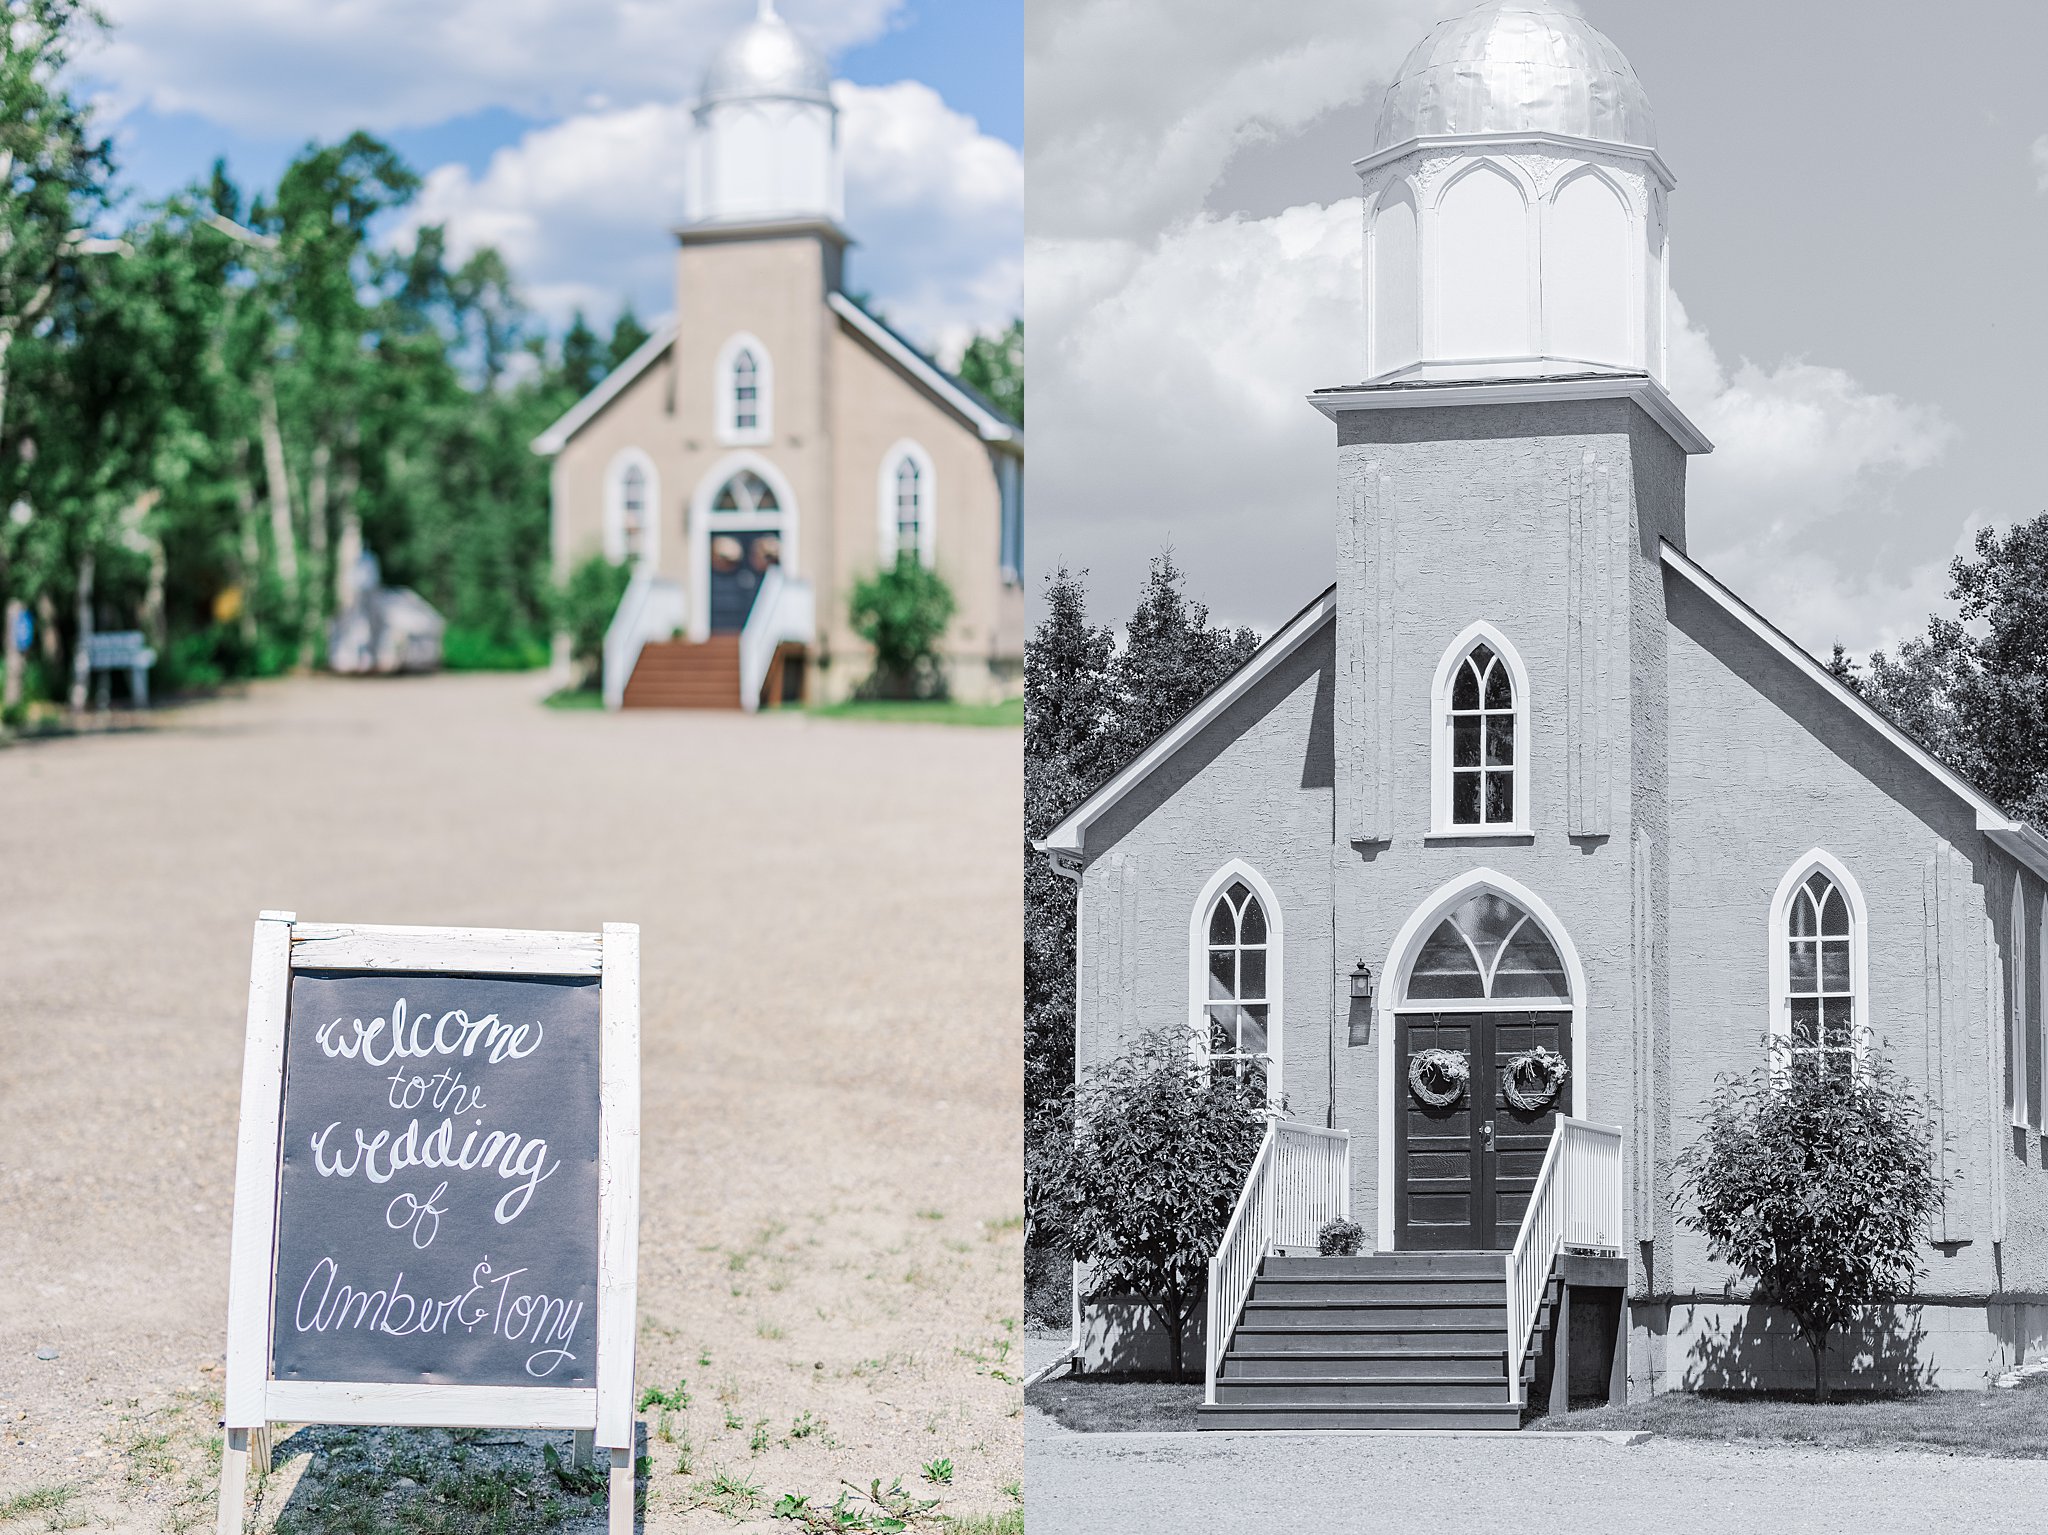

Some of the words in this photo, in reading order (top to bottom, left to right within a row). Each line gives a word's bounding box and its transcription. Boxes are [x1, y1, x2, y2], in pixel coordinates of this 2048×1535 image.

[388, 1066, 433, 1110] to
[431, 1067, 487, 1116] the
[386, 1181, 449, 1250] of
